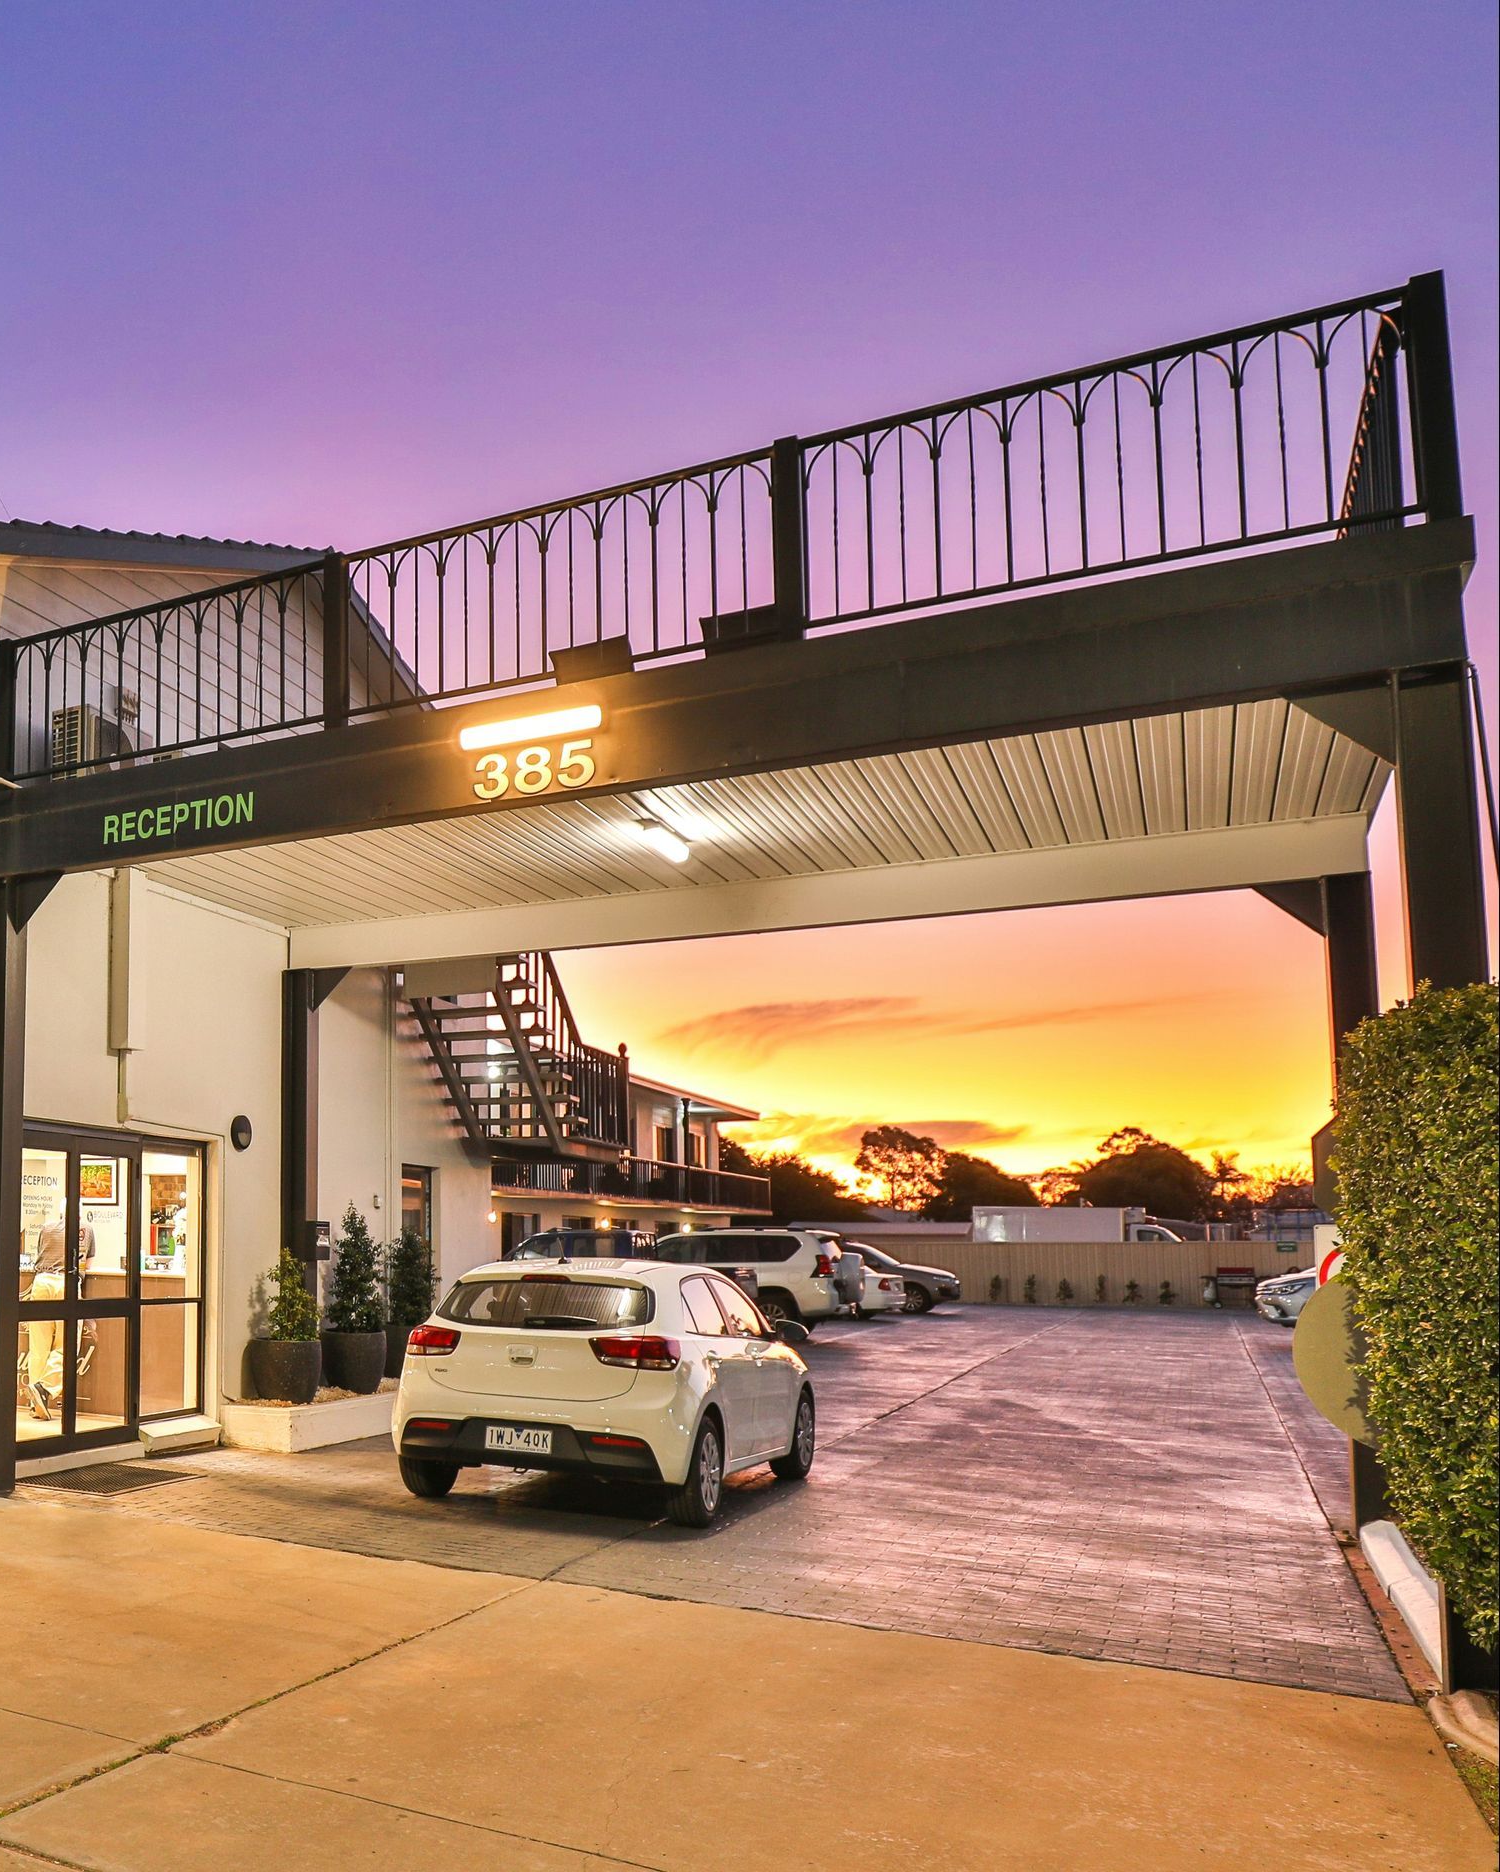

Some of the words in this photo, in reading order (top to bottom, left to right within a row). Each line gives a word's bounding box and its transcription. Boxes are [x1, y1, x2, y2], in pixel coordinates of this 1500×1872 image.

[473, 738, 596, 800] 385
[103, 791, 254, 845] RECEPTION
[20, 1174, 58, 1187] ECEPTION
